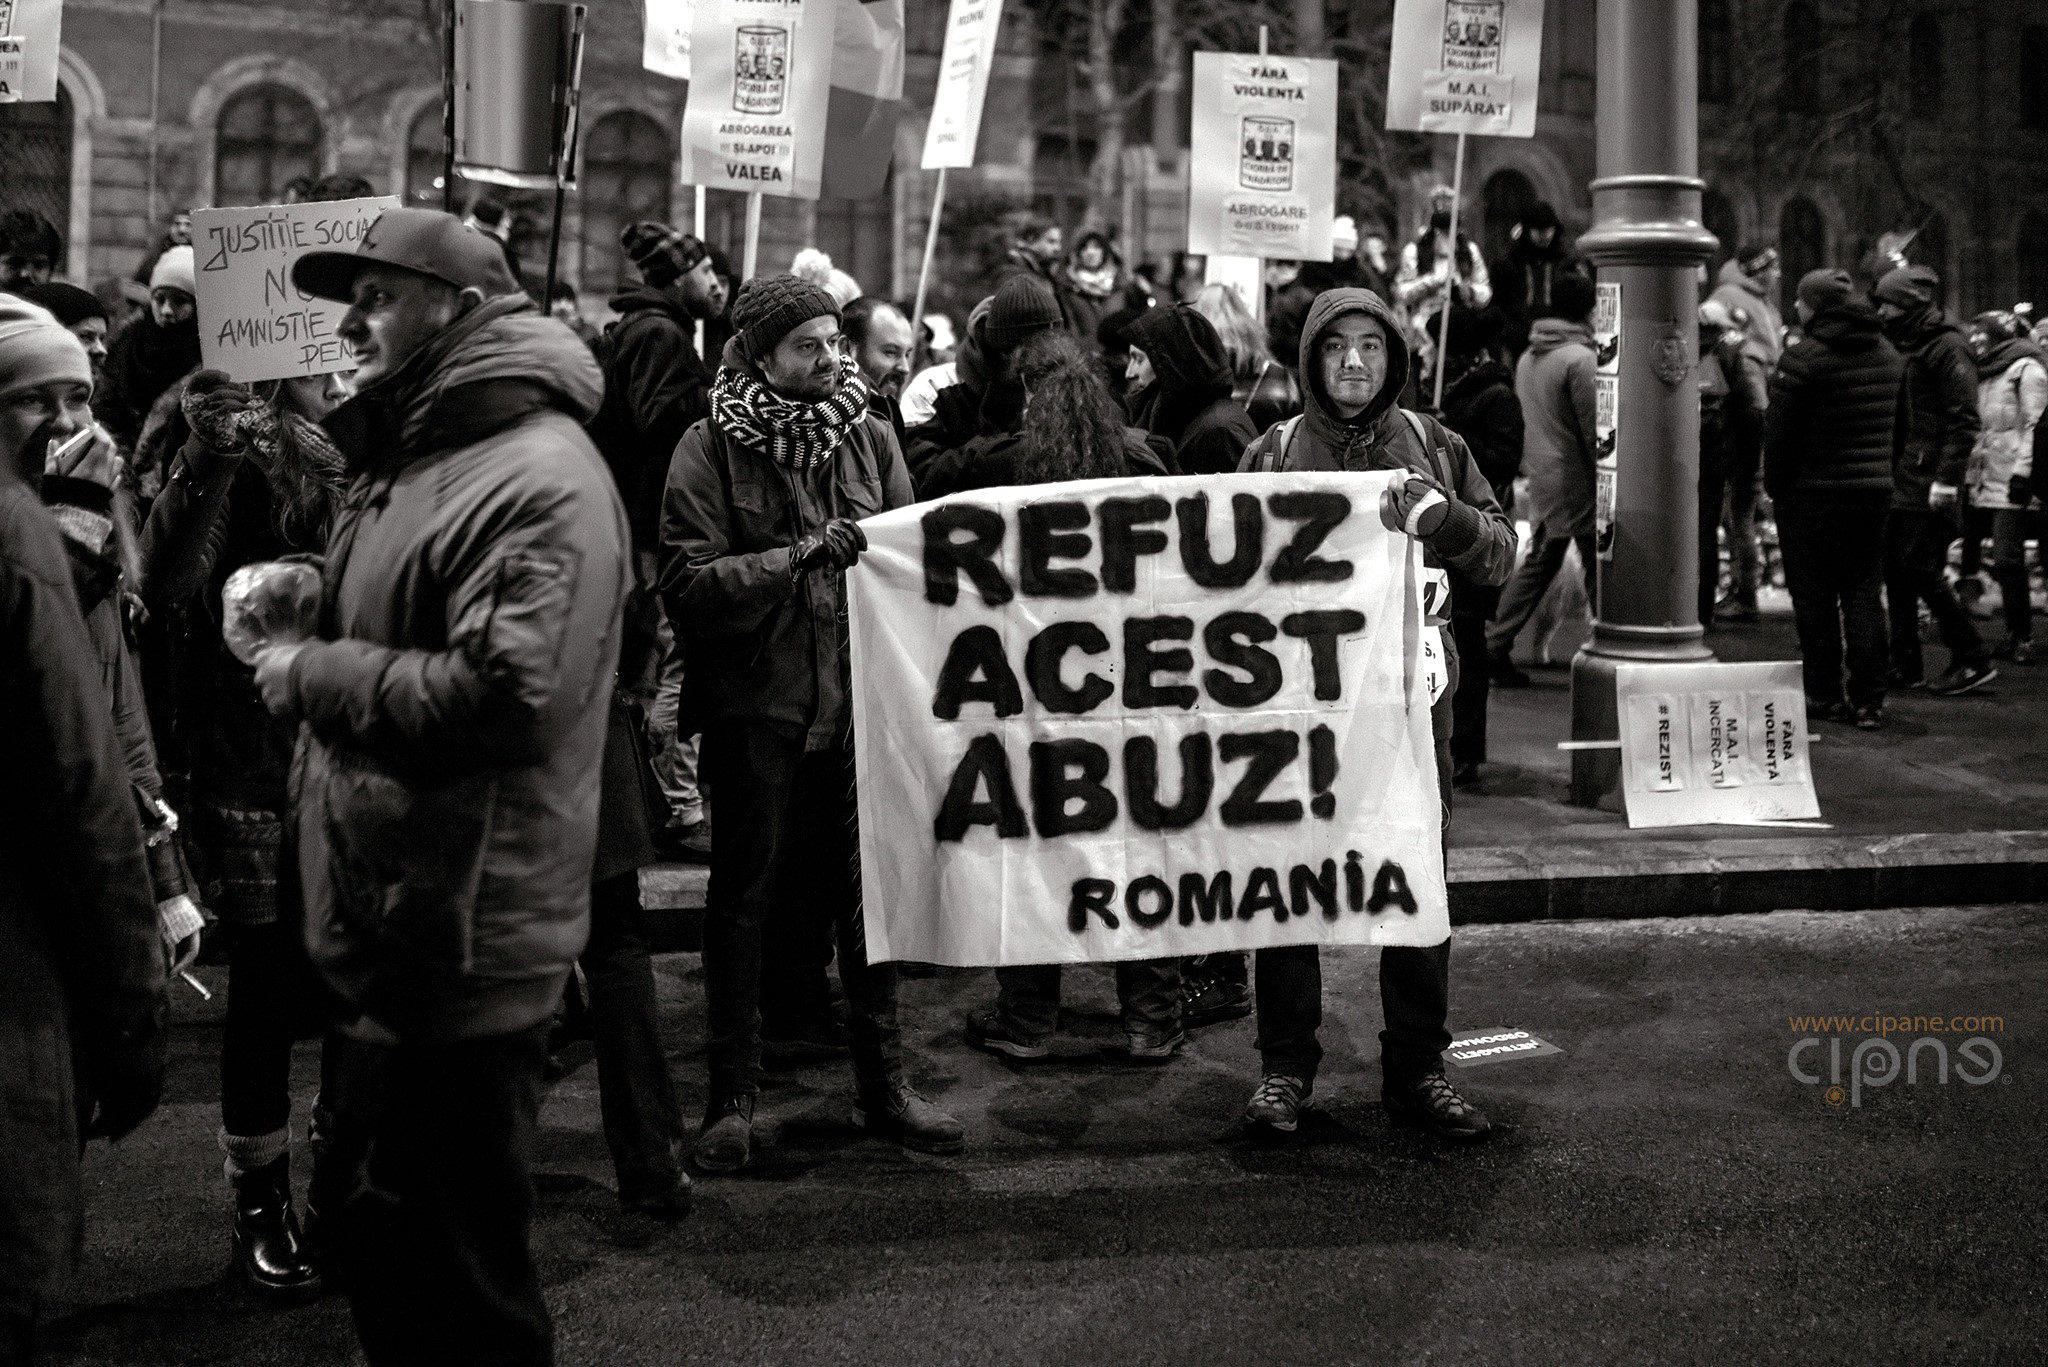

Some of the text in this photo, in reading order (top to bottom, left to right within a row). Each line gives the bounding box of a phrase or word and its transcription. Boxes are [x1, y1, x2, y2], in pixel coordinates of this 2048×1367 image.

[719, 124, 792, 136] ABROGAREA
[726, 163, 783, 182] VALEA
[1228, 203, 1307, 219] ABROGARE
[217, 309, 333, 349] AMNISTIE
[297, 338, 354, 372] PEN
[920, 490, 1356, 606] REFUZ
[932, 608, 1368, 722] ACEST
[1658, 719, 1672, 785] REZIST
[933, 724, 1339, 842] ABUZ!
